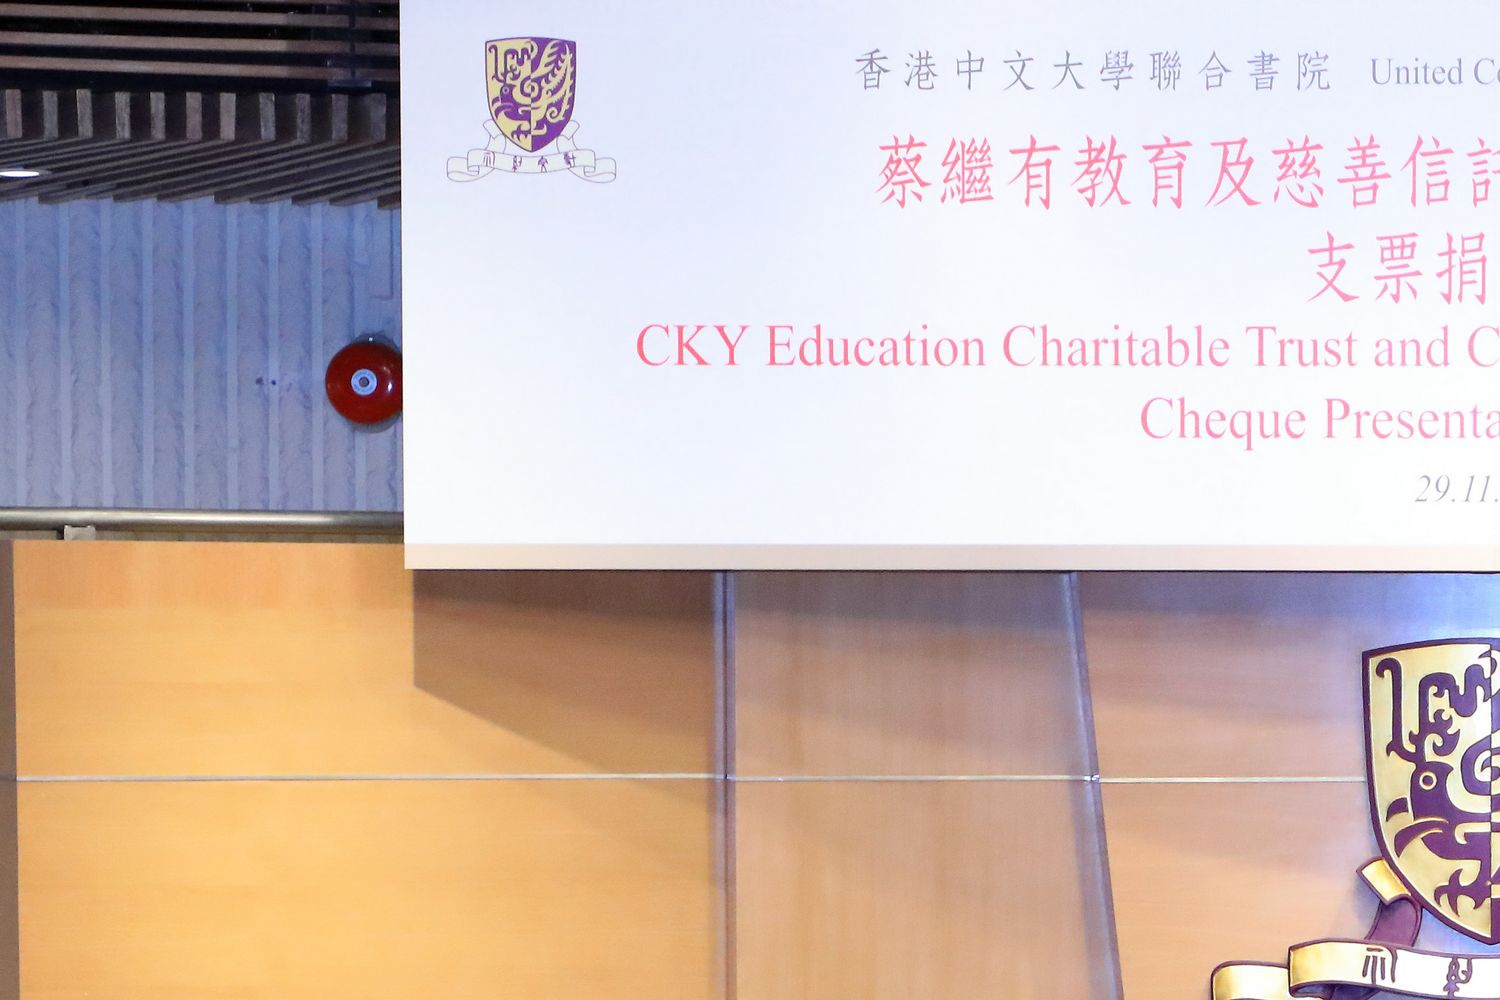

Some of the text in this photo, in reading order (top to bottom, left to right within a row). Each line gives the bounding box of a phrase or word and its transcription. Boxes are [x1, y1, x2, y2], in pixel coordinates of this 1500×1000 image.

[855, 48, 1331, 92] 香港中文大學聯合書院
[1370, 57, 1464, 86] United
[637, 324, 750, 367] CKY
[766, 323, 986, 368] Education
[1003, 324, 1231, 369] Charitable
[1245, 326, 1359, 369] Trust
[1374, 324, 1451, 368] and
[1141, 396, 1307, 452] Cheque
